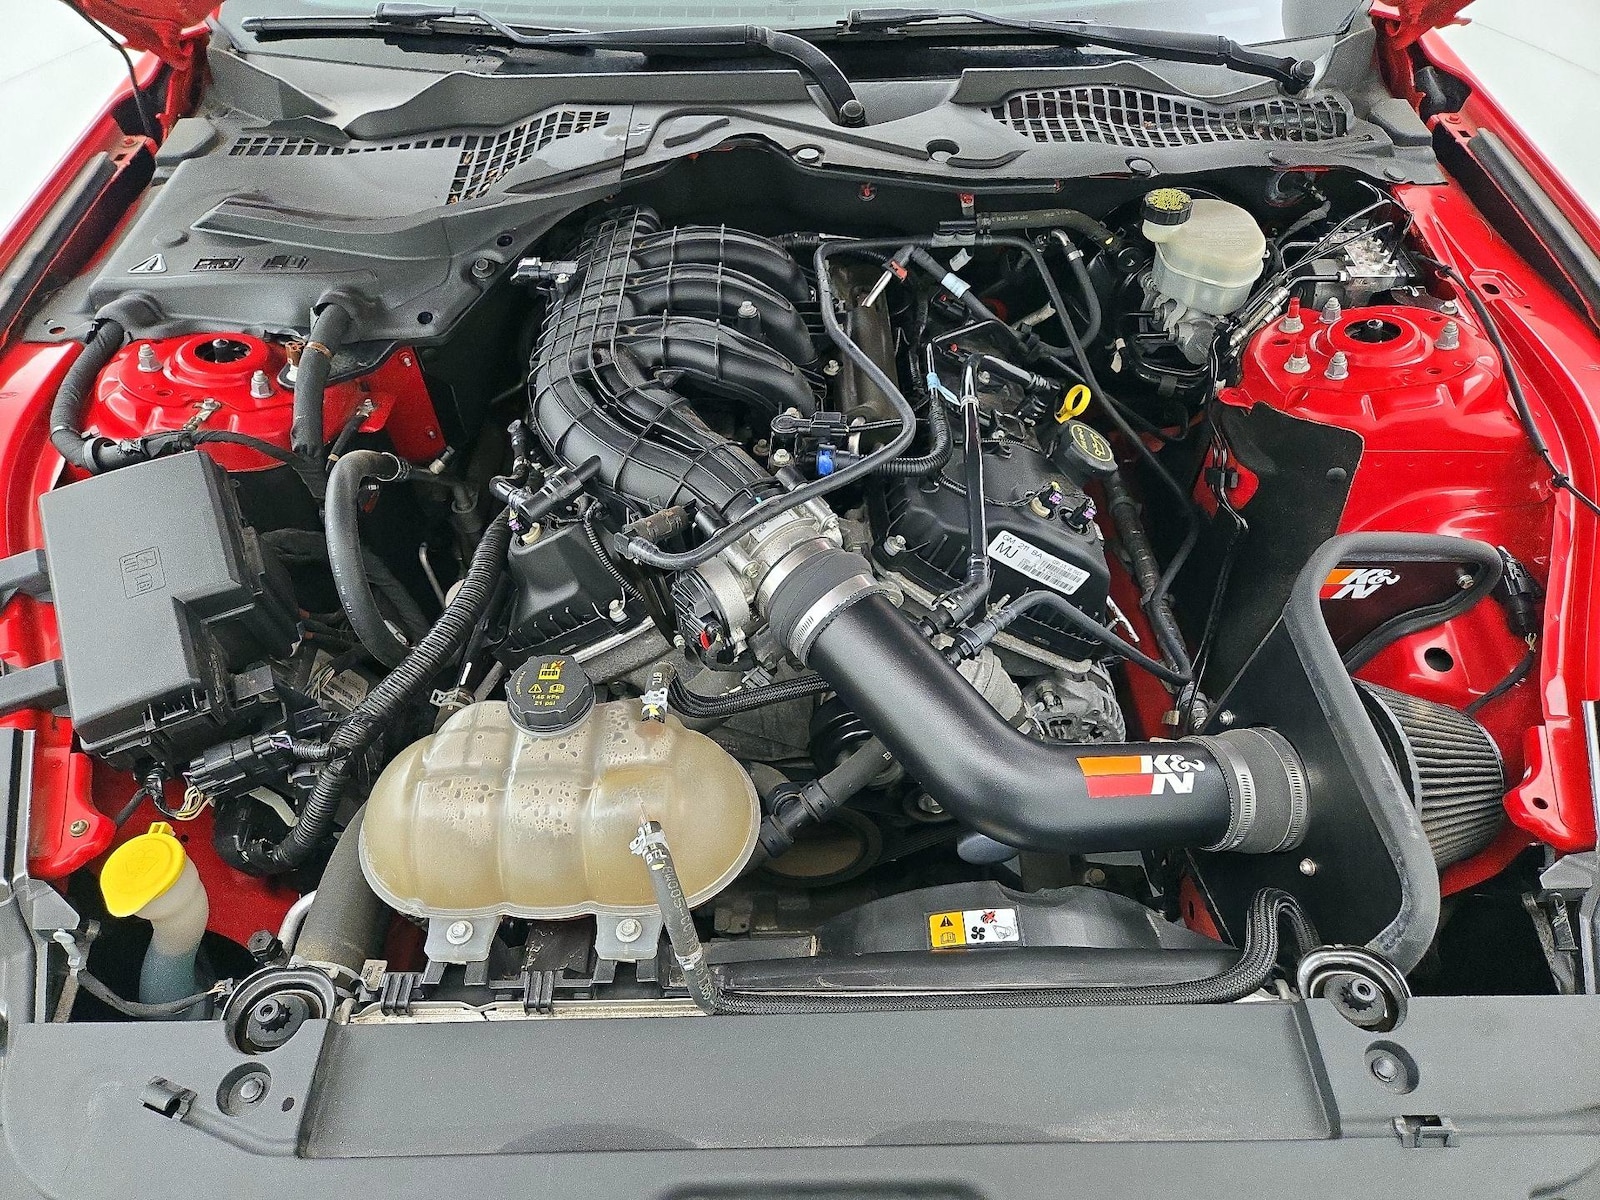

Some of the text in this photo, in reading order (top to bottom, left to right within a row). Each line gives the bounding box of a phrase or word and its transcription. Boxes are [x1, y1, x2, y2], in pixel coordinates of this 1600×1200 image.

[995, 541, 1019, 559] MJ
[1031, 550, 1043, 559] BA
[1330, 568, 1401, 599] K&N
[652, 671, 663, 686] BTL
[1139, 754, 1206, 795] K&N
[645, 848, 668, 866] BTL
